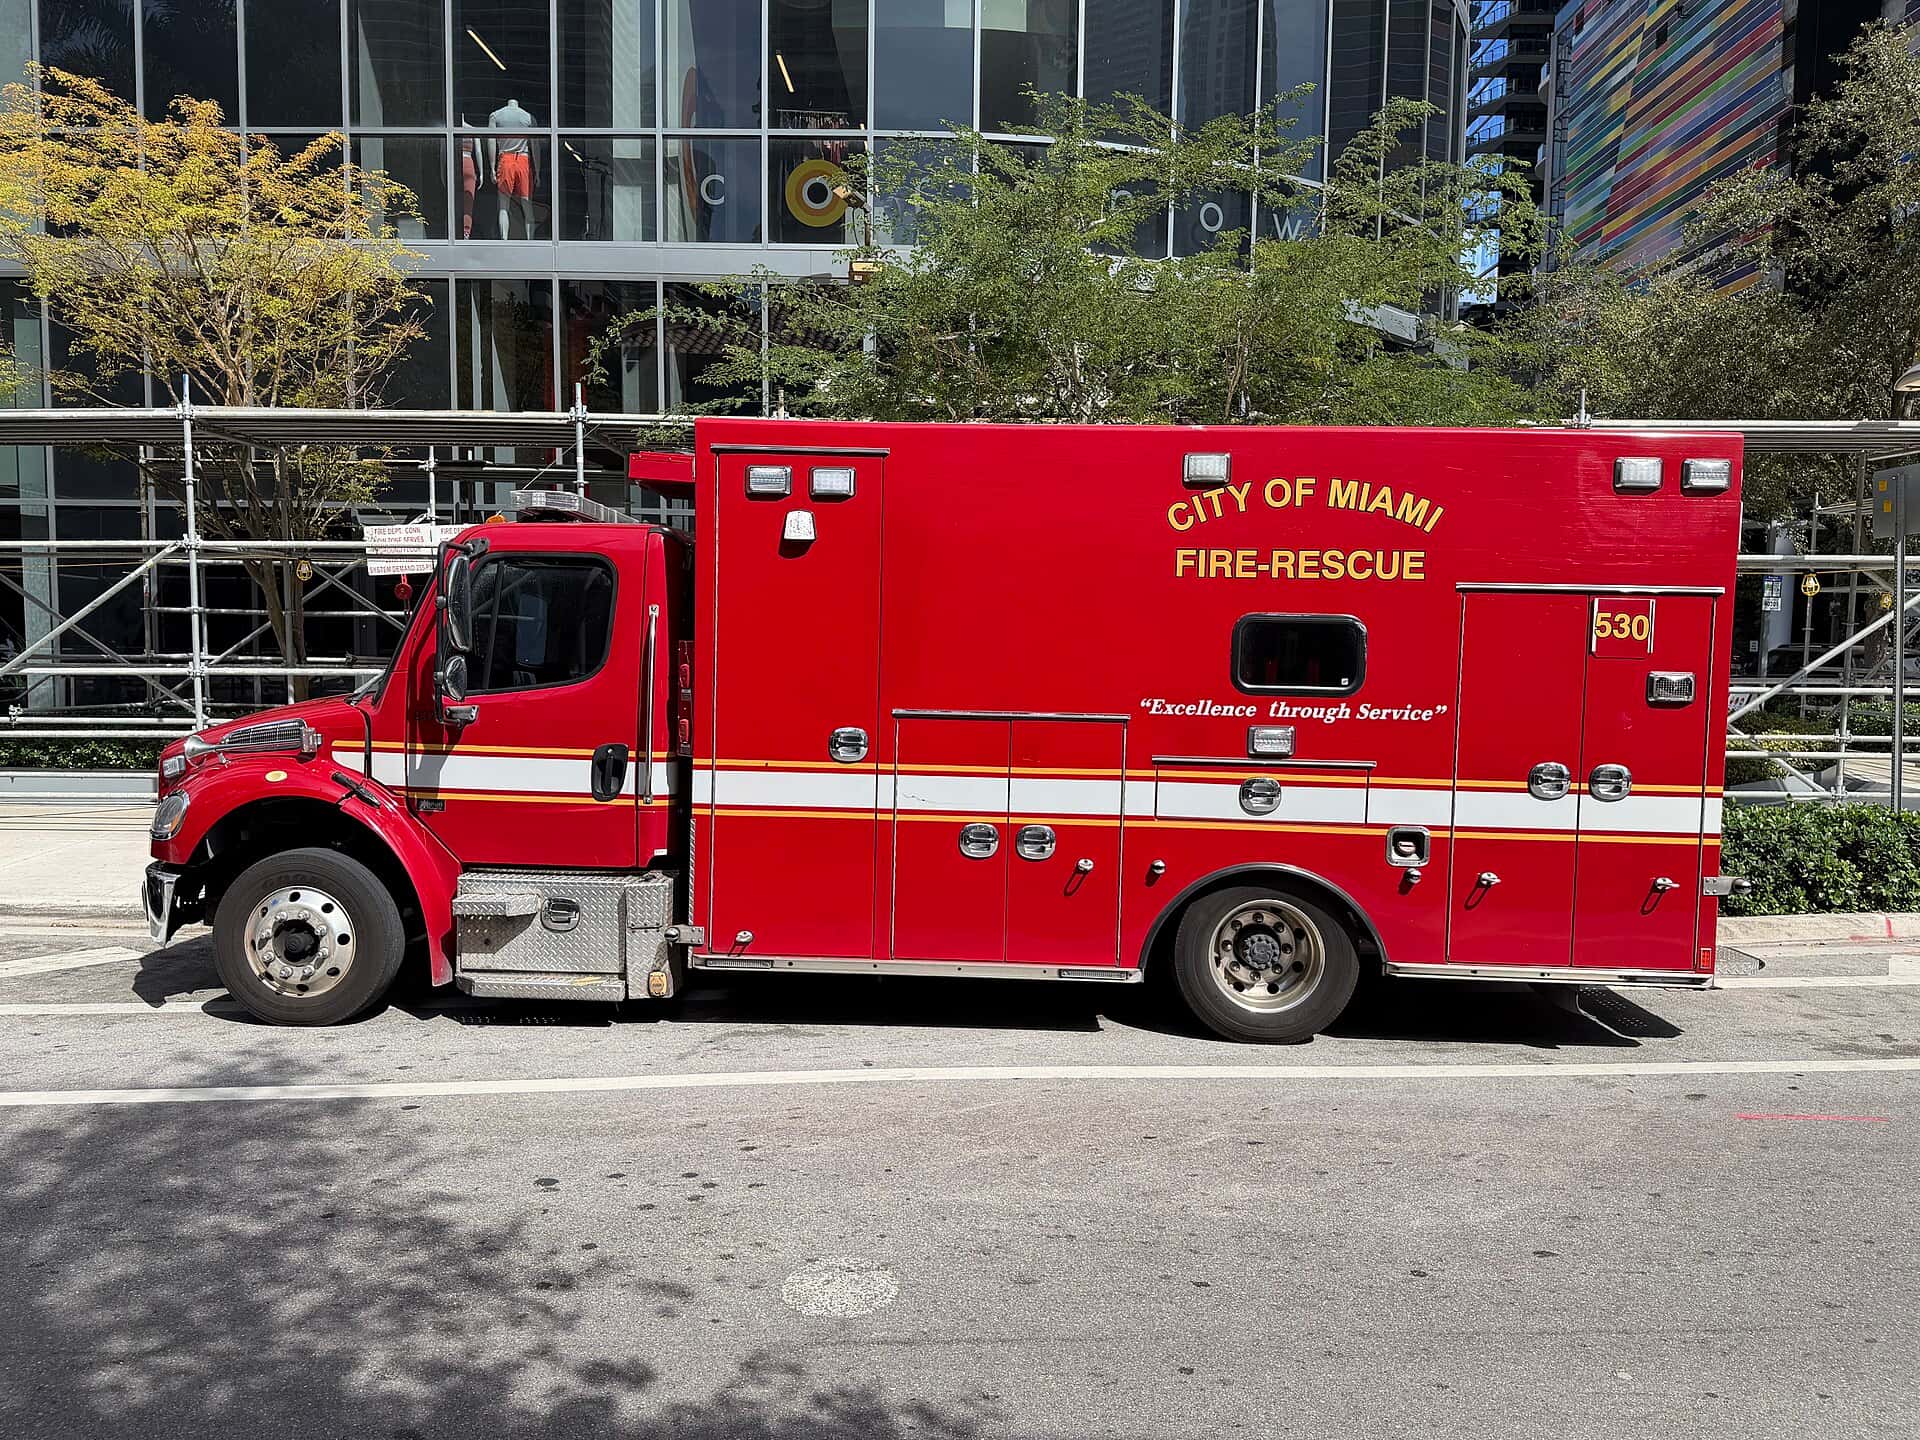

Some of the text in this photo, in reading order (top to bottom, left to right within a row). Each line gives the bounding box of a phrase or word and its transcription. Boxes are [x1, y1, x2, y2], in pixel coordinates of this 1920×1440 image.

[1167, 477, 1445, 534] CITY OF MIAMI
[1175, 549, 1426, 580] FIRE-RESCUE
[1595, 612, 1650, 641] 530
[1140, 698, 1448, 724] “Excellence through Service”
